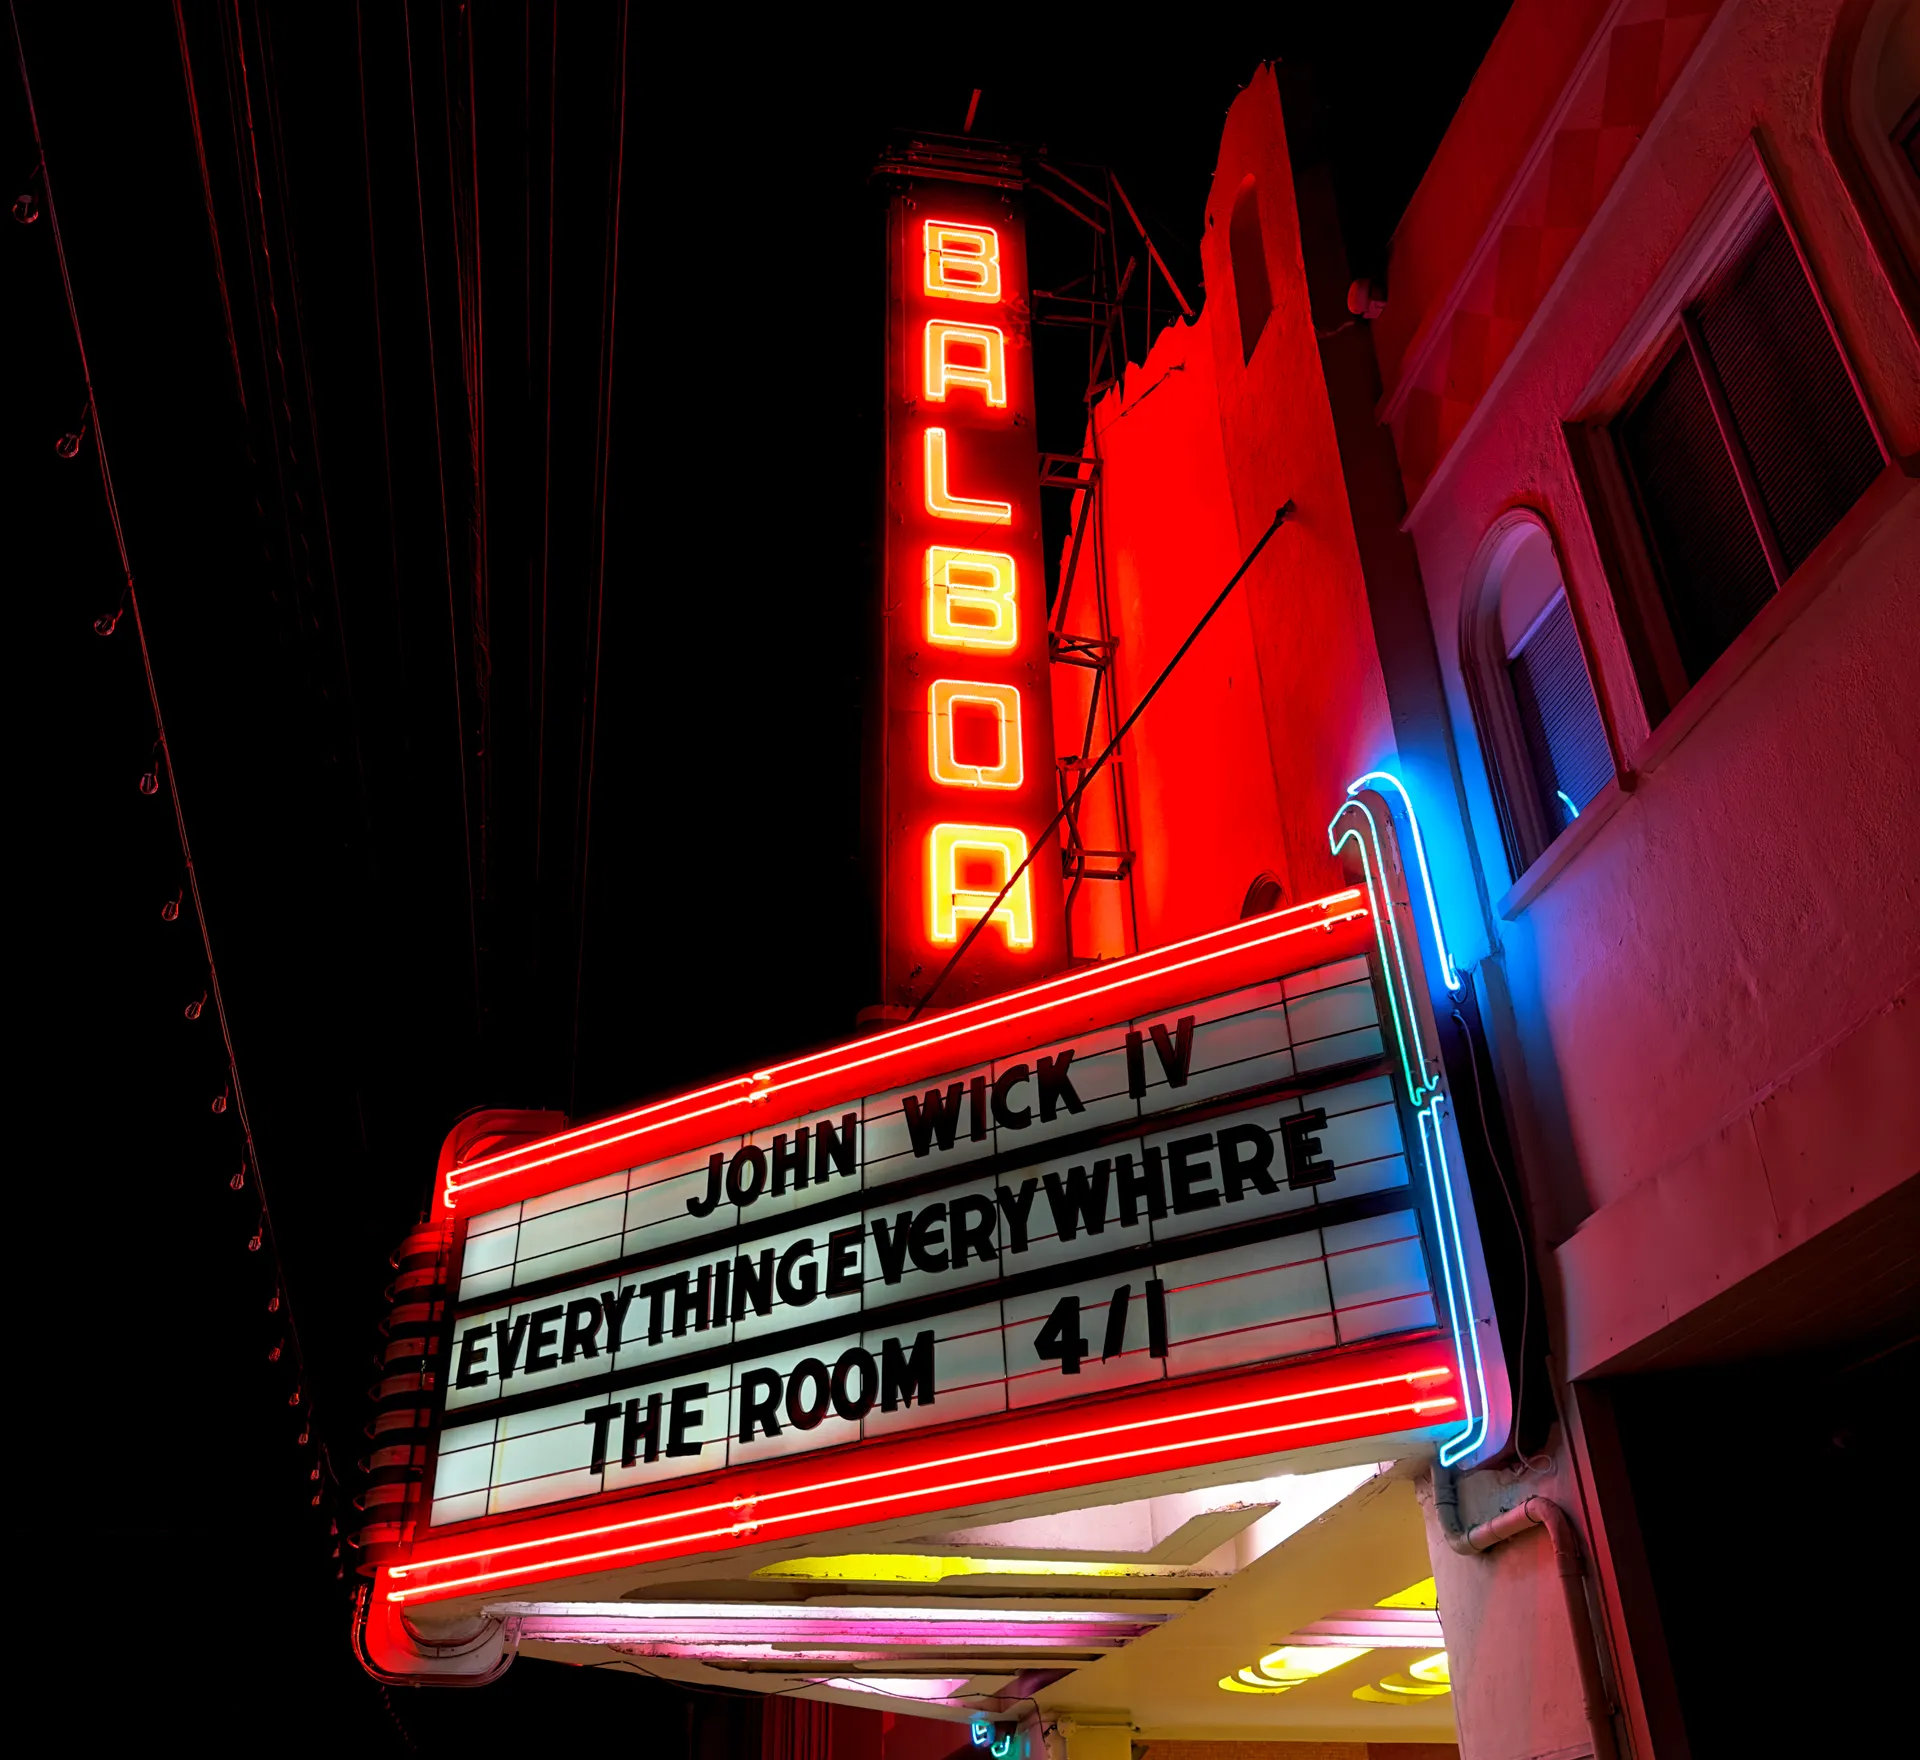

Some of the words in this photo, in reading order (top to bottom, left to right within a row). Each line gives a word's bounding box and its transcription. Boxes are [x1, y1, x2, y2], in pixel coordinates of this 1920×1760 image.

[922, 217, 1036, 952] BALBOA
[685, 1112, 857, 1218] JOHN
[902, 1050, 1086, 1158] WICK
[1125, 1015, 1196, 1100] IV
[584, 1381, 710, 1475] THE
[738, 1329, 936, 1444] ROOM
[1033, 1279, 1169, 1375] 4/1
